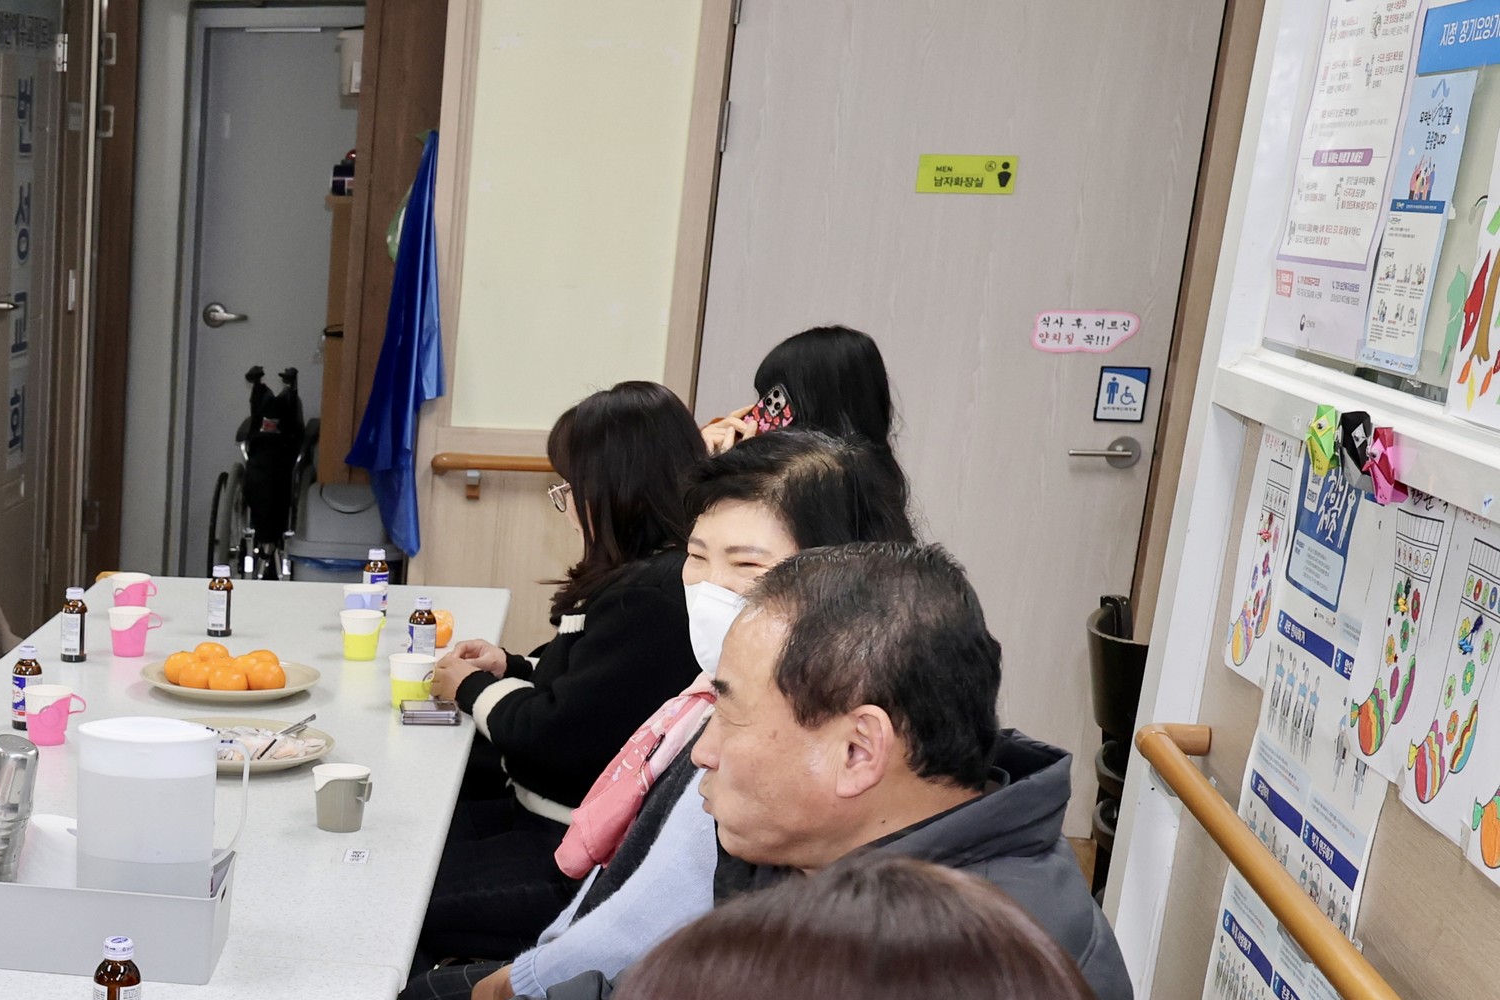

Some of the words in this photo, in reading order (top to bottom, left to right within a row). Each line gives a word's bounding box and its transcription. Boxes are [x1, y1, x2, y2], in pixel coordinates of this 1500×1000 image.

[1439, 20, 1458, 46] 지정
[1458, 13, 1500, 44] 장기요양기
[934, 176, 984, 188] 남자화장실
[1041, 316, 1064, 328] 식사
[1071, 318, 1087, 329] 후,
[1095, 319, 1131, 332] 어르신
[1038, 332, 1075, 345] 양치질
[1083, 334, 1110, 346] 꼭!!!
